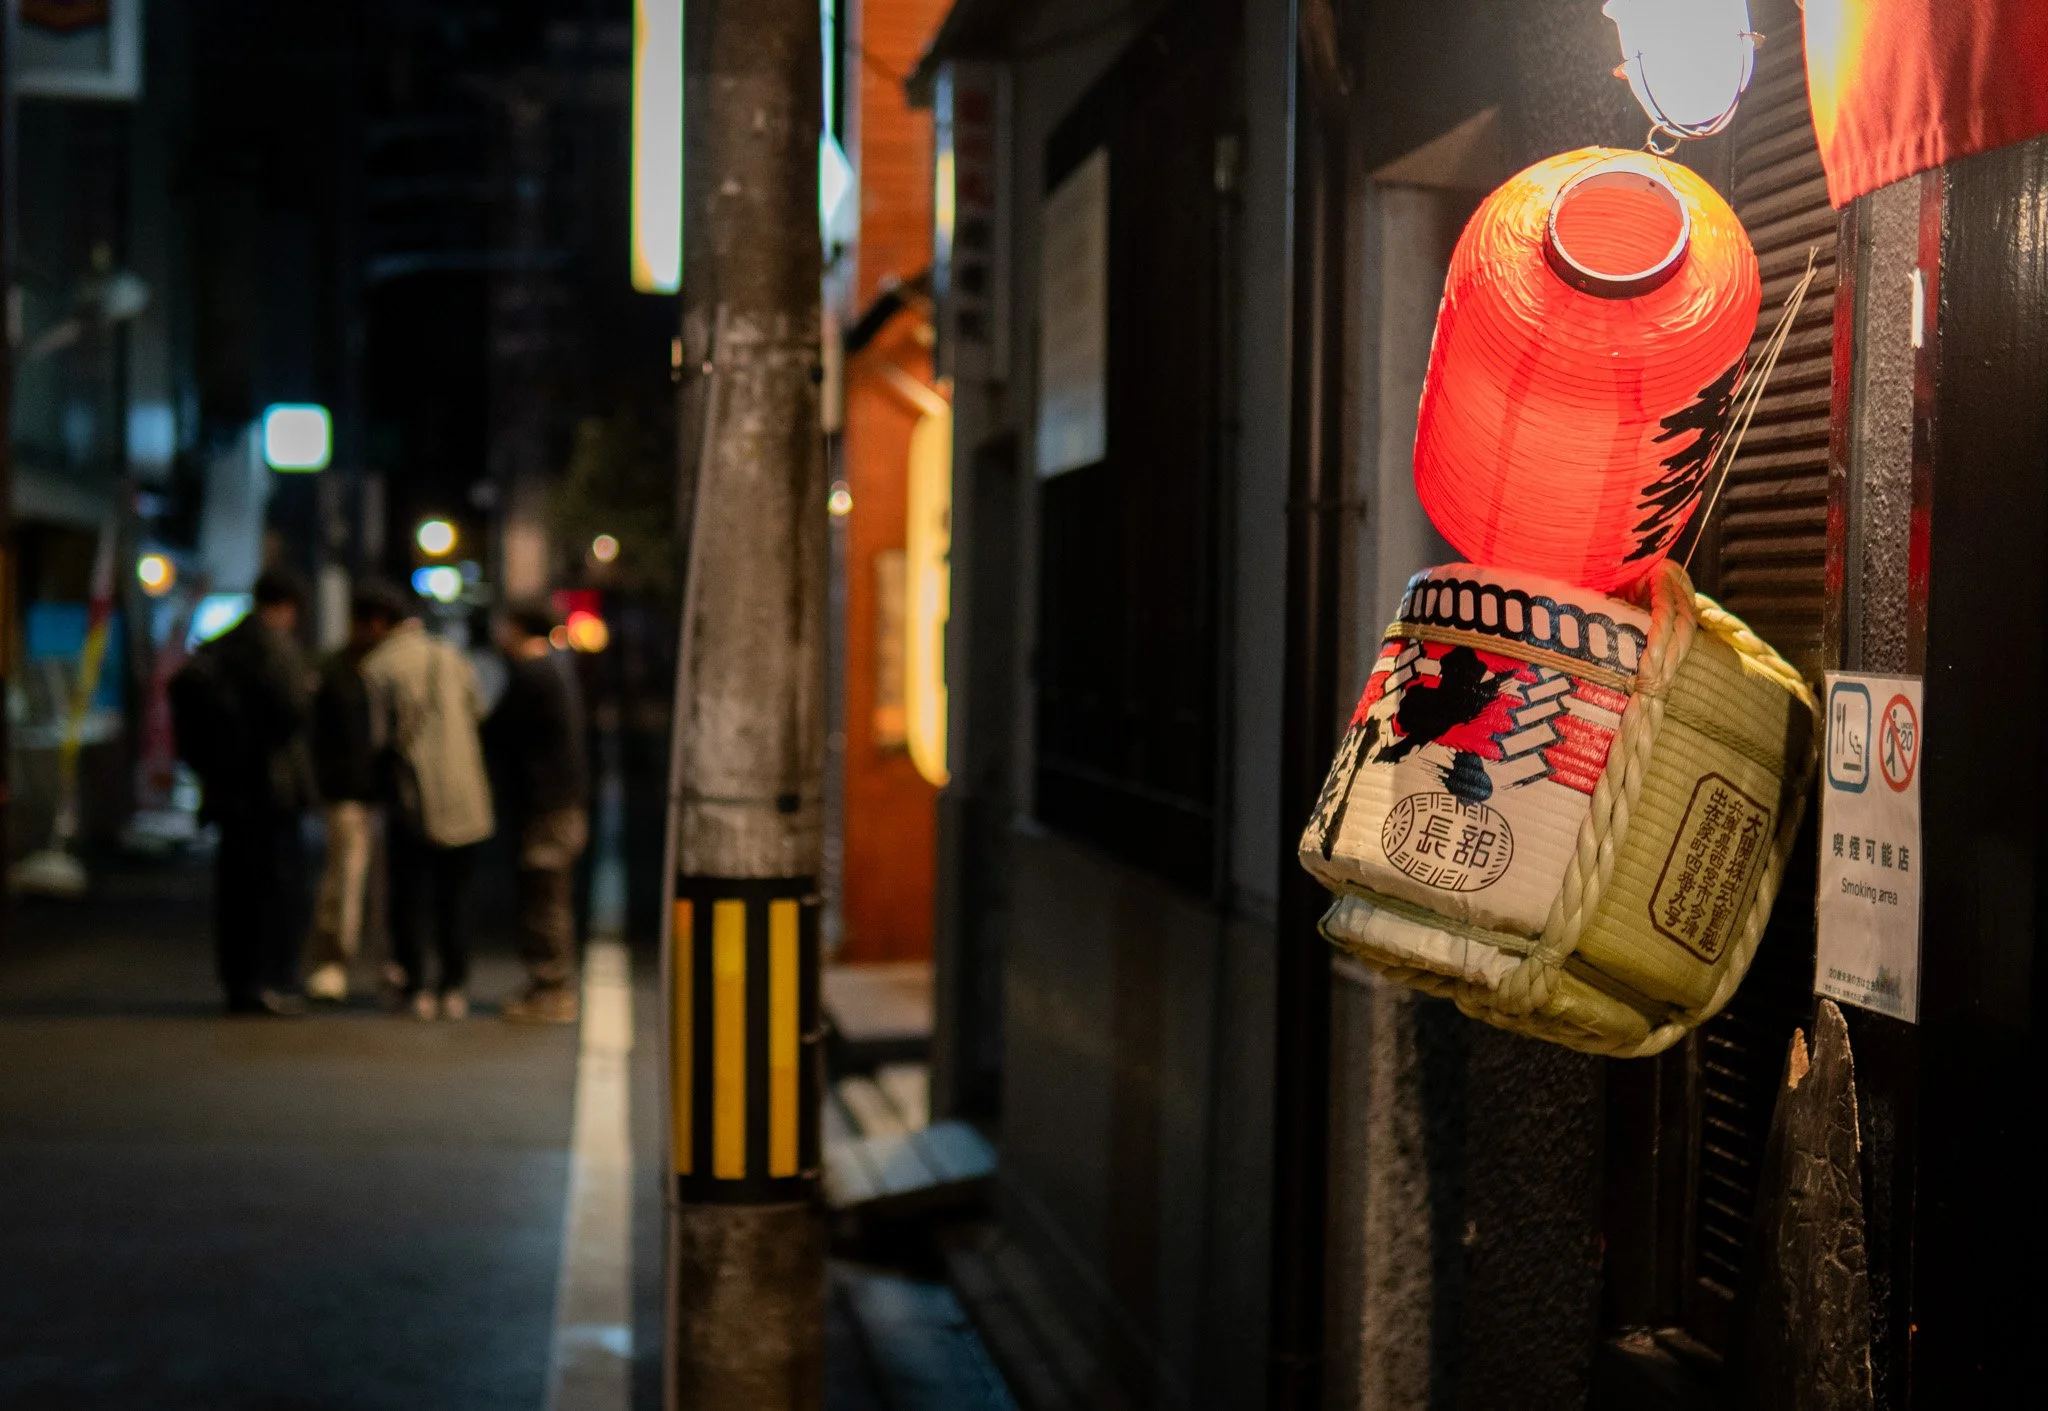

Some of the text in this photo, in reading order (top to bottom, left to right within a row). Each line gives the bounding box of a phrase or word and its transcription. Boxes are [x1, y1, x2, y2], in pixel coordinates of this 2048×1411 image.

[1900, 730, 1914, 752] 20
[1832, 832, 1910, 872] 喫煙可能店
[1841, 876, 1898, 906] Smoking area
